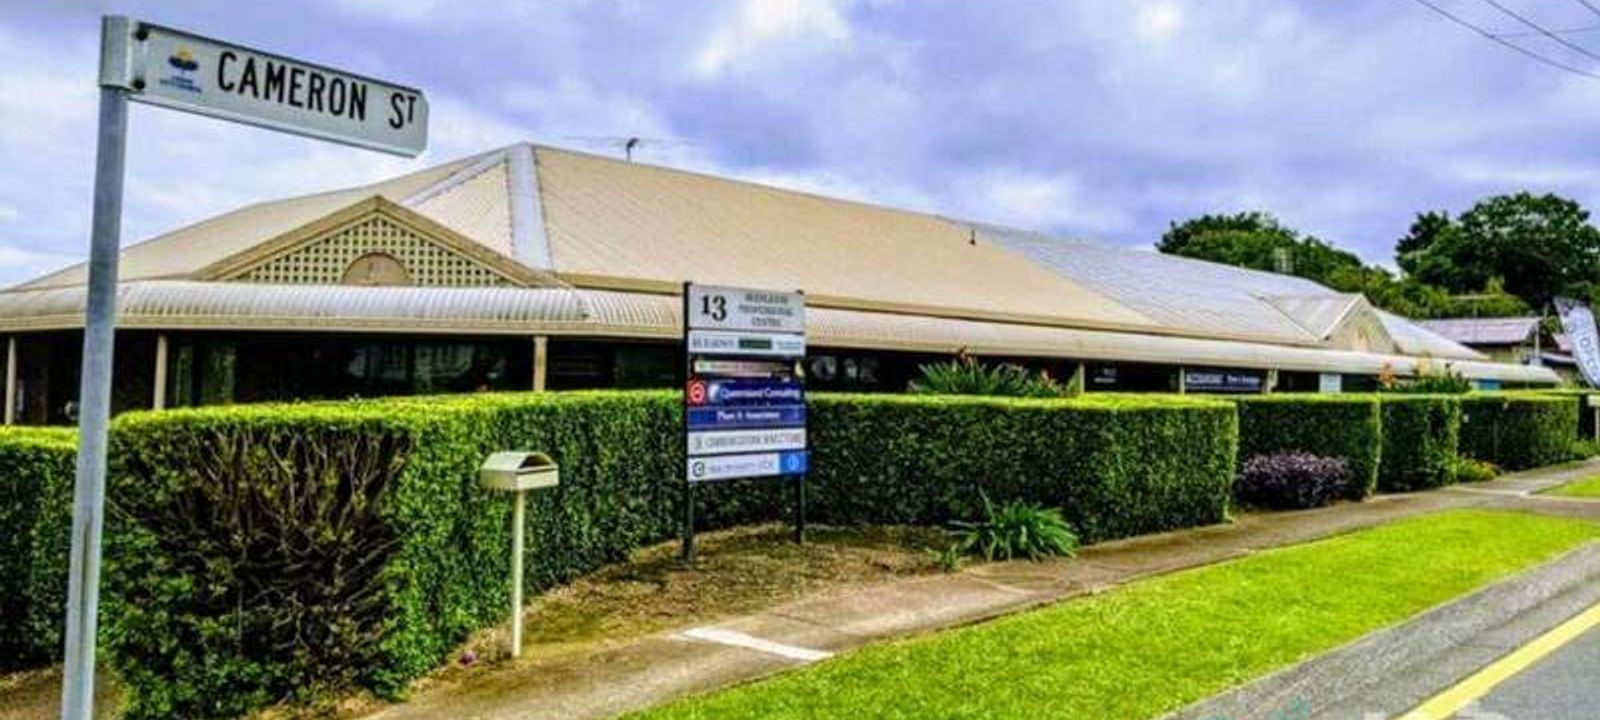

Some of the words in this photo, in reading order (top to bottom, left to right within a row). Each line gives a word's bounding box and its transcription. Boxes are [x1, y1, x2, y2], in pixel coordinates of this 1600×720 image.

[217, 51, 368, 121] CAMERON
[388, 92, 418, 130] ST
[701, 295, 727, 321] 13
